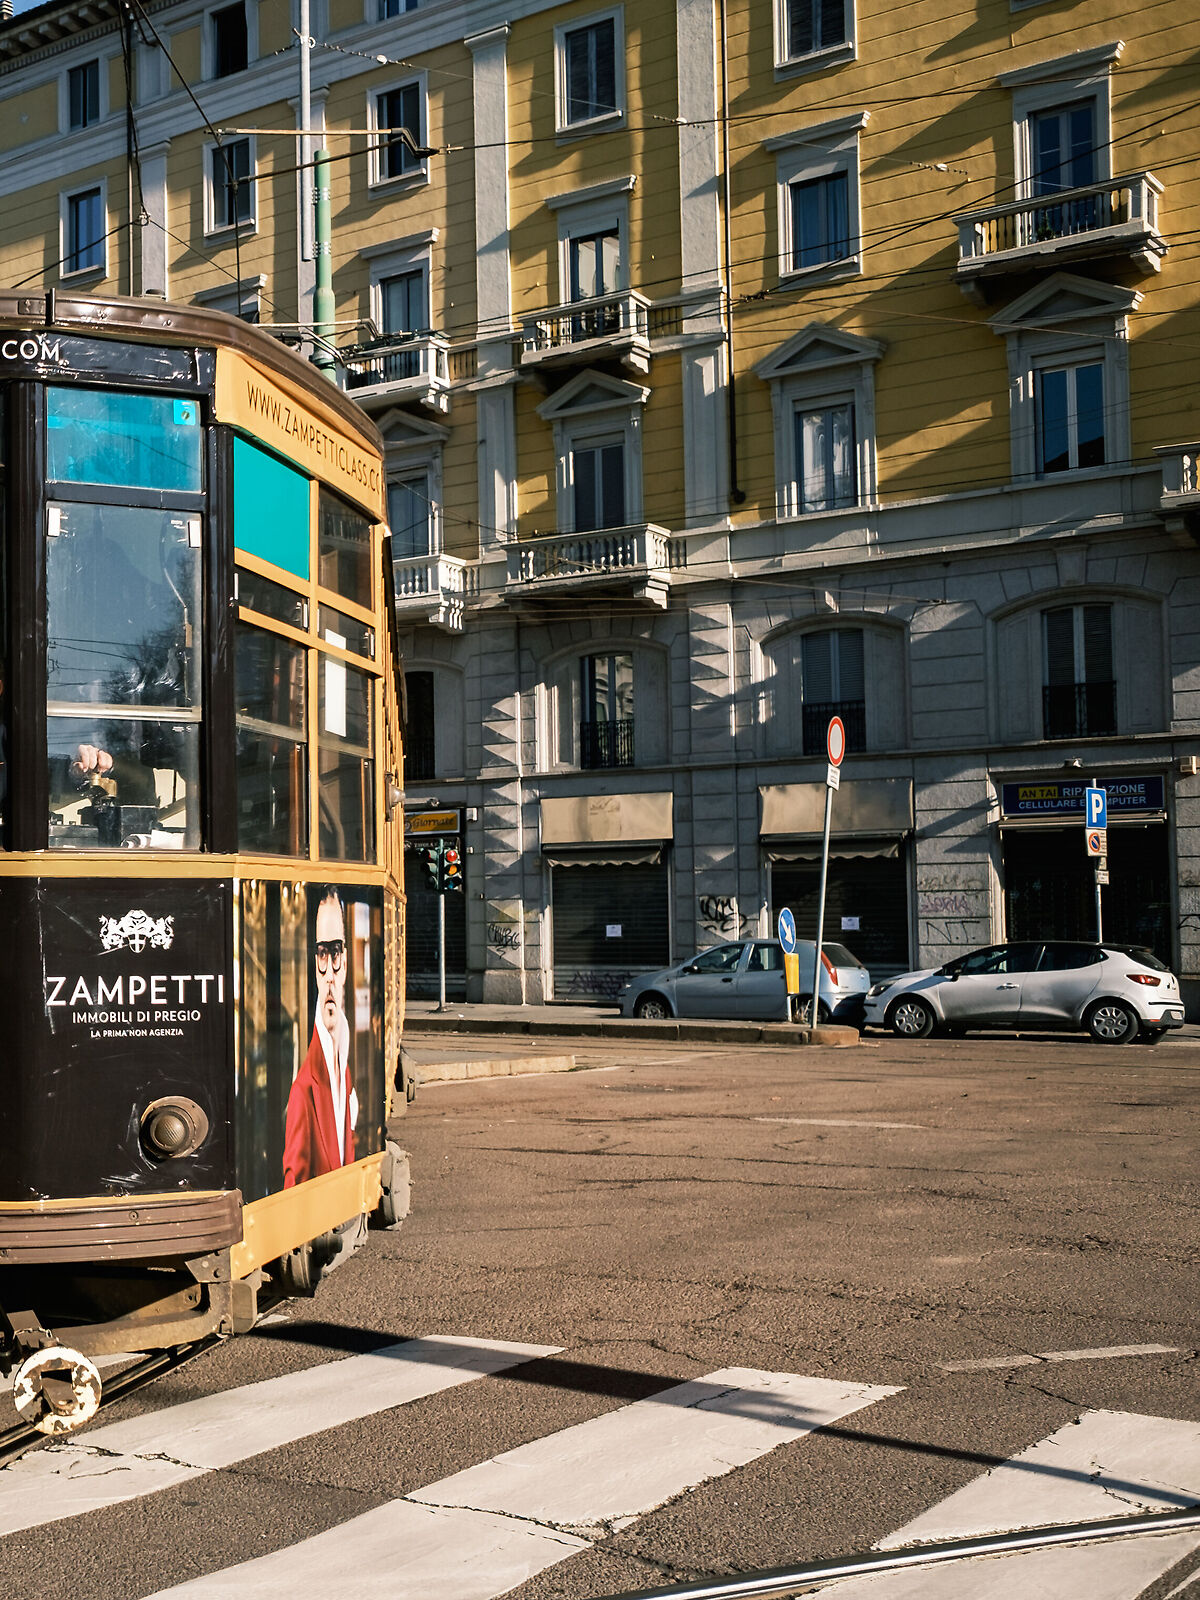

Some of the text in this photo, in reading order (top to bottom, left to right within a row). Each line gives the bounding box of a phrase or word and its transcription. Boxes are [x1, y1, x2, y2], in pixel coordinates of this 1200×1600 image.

[1018, 799, 1077, 809] CELLULARE
[1091, 793, 1104, 823] P
[46, 974, 224, 1006] ZAMPETTI
[72, 1009, 201, 1024] IMMOBILI DI PREGIO
[90, 1028, 184, 1038] LA PRIMA NON AGENZIA
